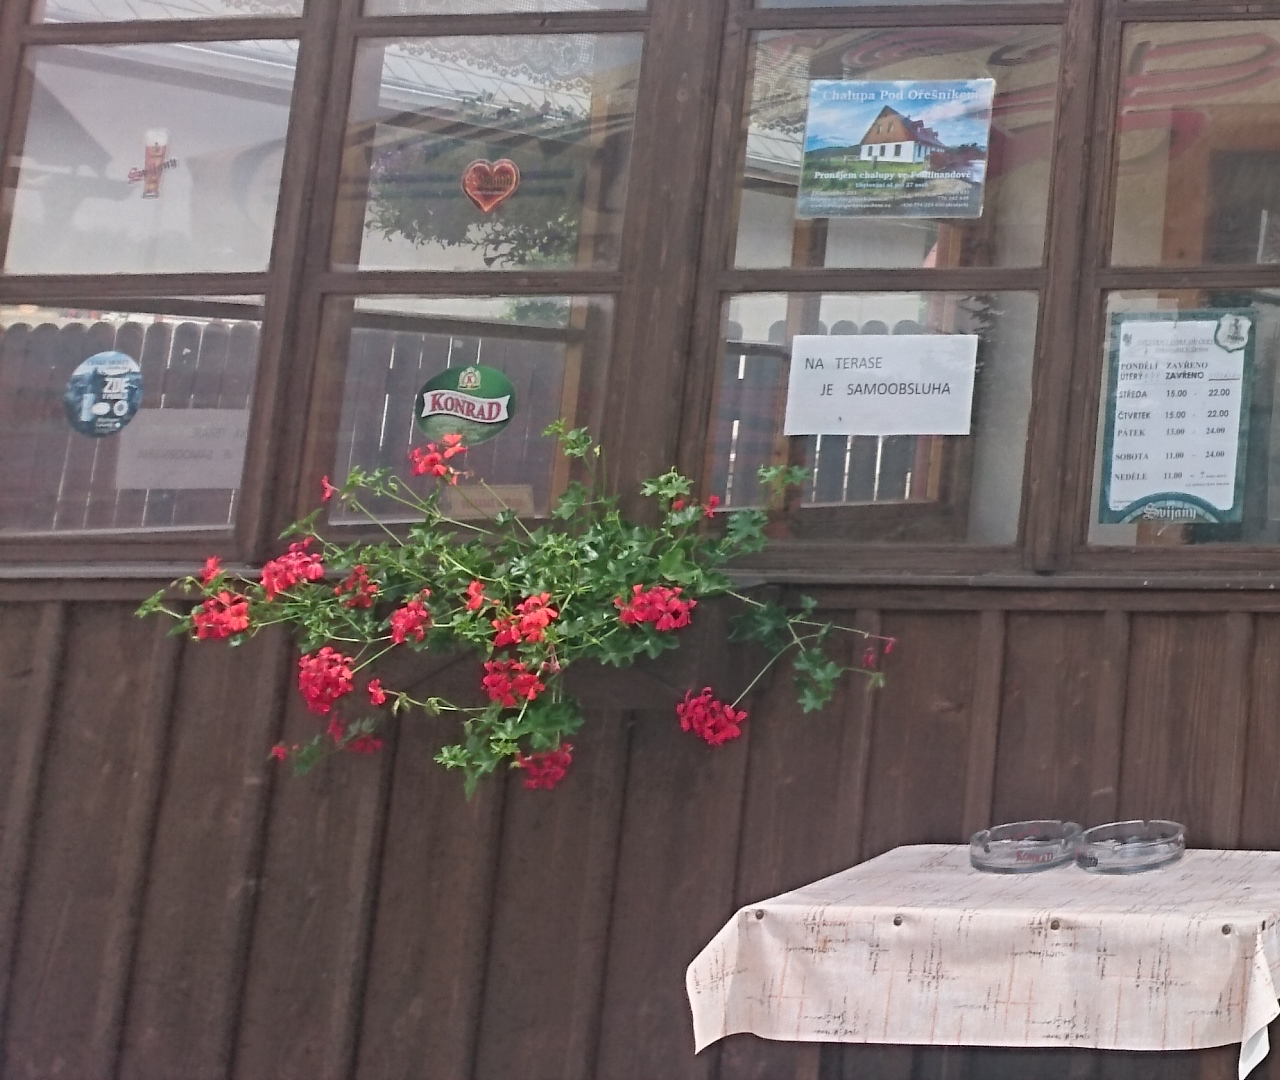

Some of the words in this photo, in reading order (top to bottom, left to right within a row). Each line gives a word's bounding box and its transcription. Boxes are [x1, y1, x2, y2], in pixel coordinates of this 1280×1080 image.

[822, 90, 875, 103] Chalupa
[880, 89, 903, 100] Pod
[814, 171, 857, 180] Pronájem
[860, 171, 895, 180] chalupy
[805, 357, 824, 370] NA
[835, 356, 883, 370] TERASE
[1120, 361, 1158, 370] PONDĚLÍ
[1166, 360, 1208, 369] ZAVŘENO
[1120, 372, 1143, 380] ÚTERÝ
[1166, 371, 1204, 379] ZAVŘENO
[820, 383, 833, 396] JE
[847, 382, 951, 395] SAMOOBSLUHA
[1119, 389, 1147, 399] STŘEDA
[1208, 389, 1230, 397] 22.00
[429, 392, 502, 422] KONRAD
[1118, 411, 1151, 420] ČTVRTEK
[1166, 411, 1186, 419] 15.00
[1207, 410, 1229, 418] 22.00
[1117, 427, 1146, 437] PÁTEK
[1206, 427, 1226, 435] 24.00
[1115, 452, 1149, 461] SOBOTA
[1205, 450, 1225, 458] 24.00
[1114, 471, 1148, 481] NEDĚLE
[1163, 471, 1183, 480] 11.00
[1143, 502, 1197, 520] Svijany
